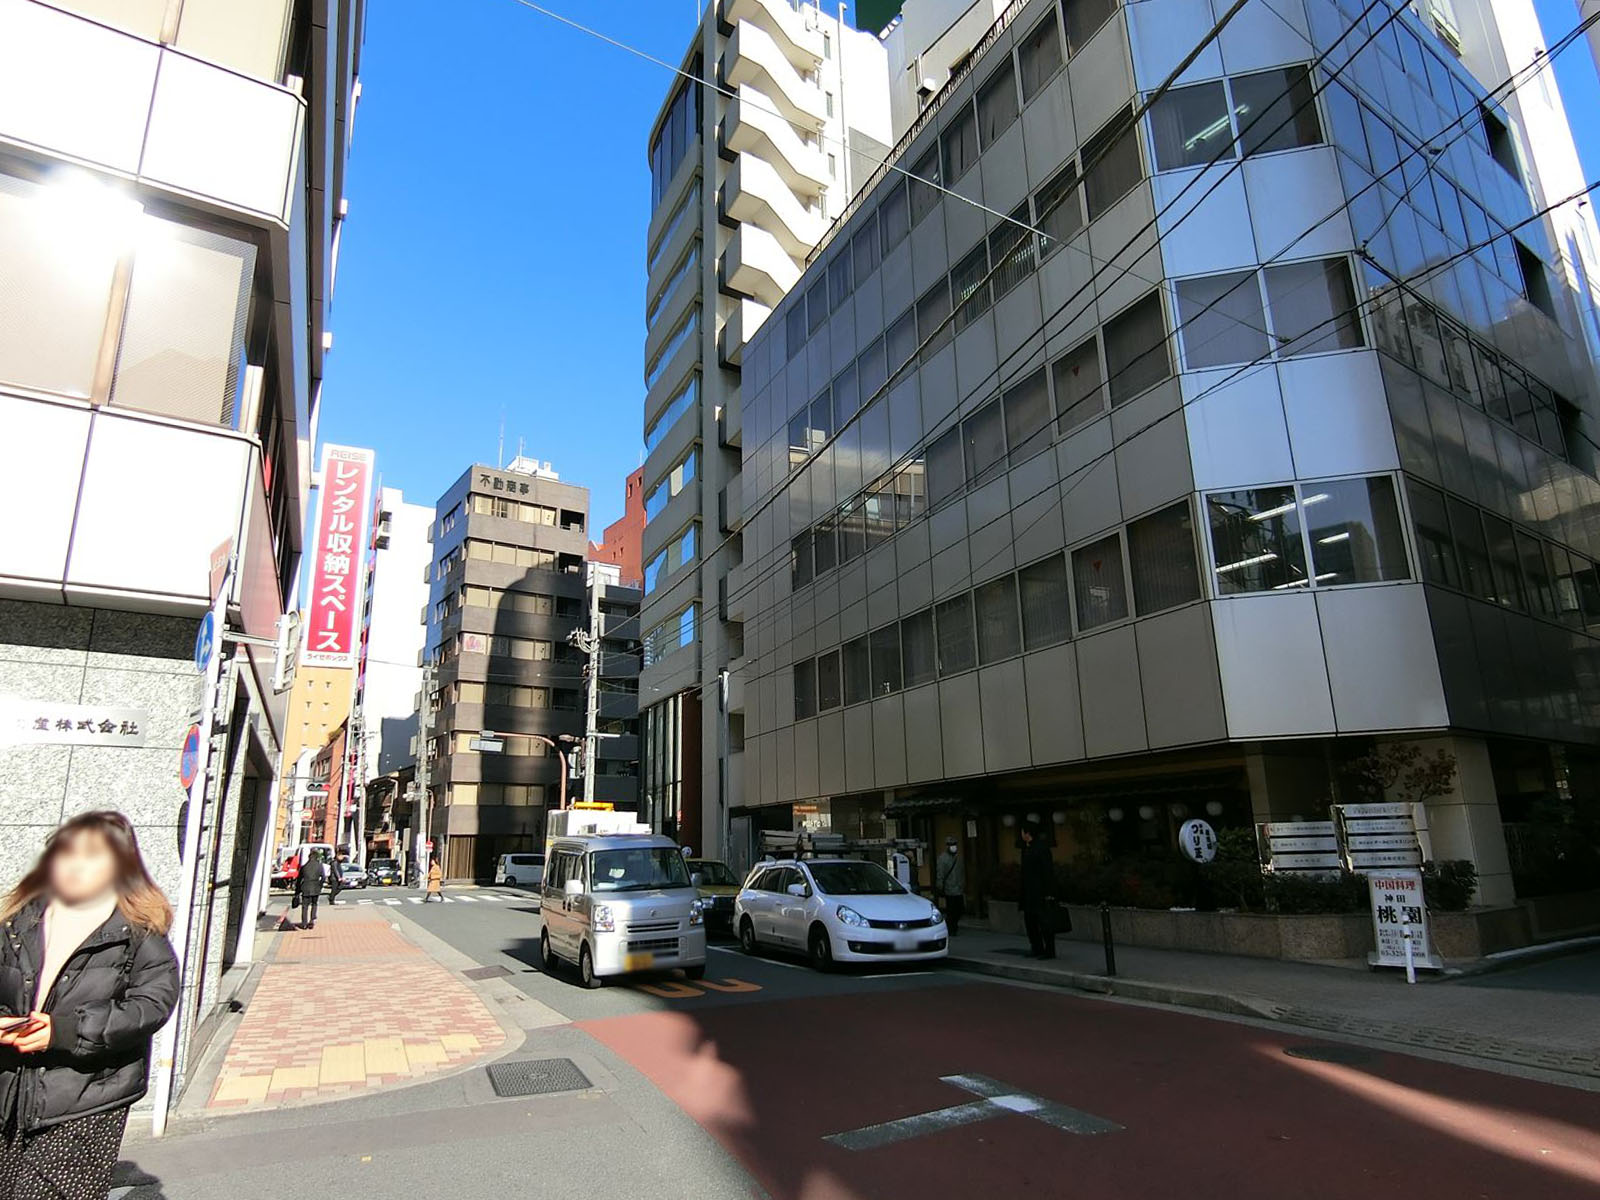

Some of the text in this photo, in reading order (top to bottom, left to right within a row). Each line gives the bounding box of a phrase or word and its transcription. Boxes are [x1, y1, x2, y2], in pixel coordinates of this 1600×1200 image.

[316, 461, 359, 651] レンタル収納スペース
[1375, 879, 1416, 891] 中国料理
[1377, 905, 1422, 924] 桃園
